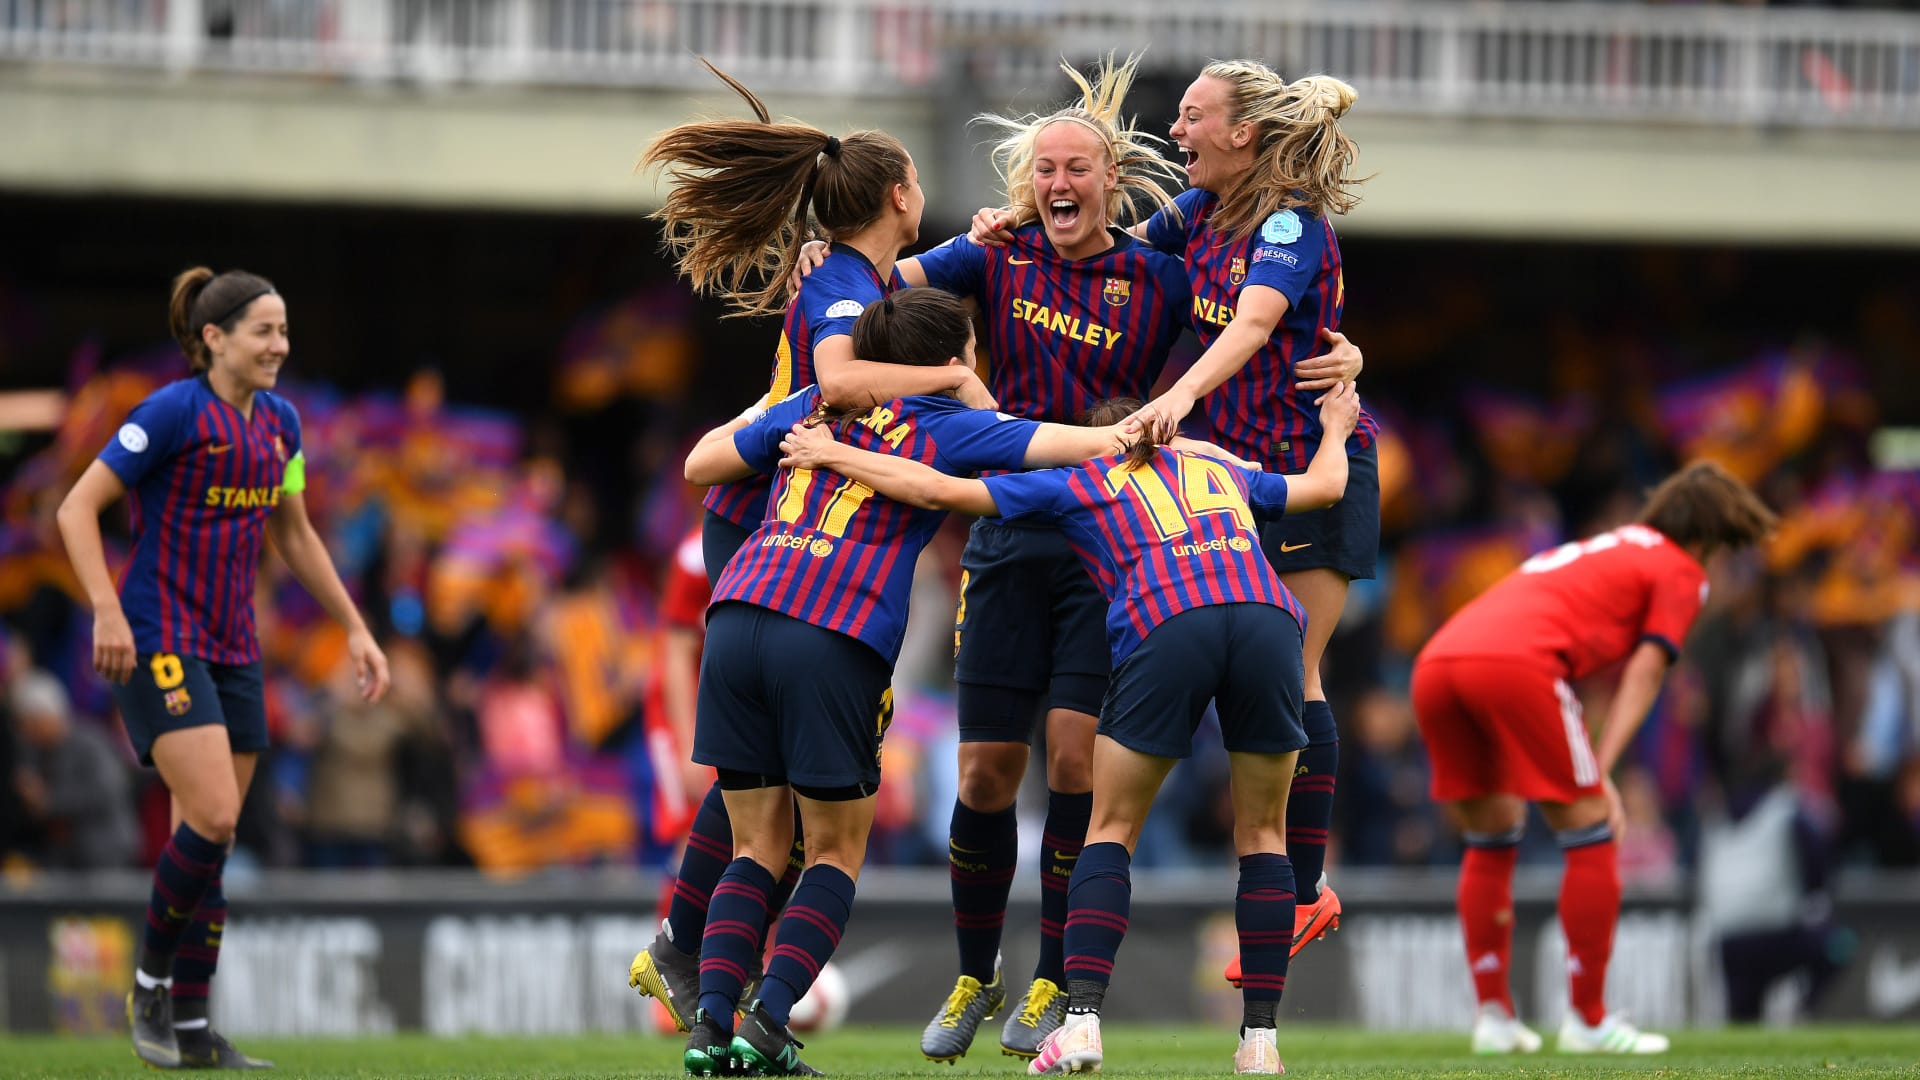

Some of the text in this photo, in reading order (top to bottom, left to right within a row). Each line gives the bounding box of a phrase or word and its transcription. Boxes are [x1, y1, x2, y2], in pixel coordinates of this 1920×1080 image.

[1262, 249, 1298, 266] RESPECT
[1012, 297, 1122, 350] STANLEY
[205, 485, 282, 508] STANLE
[1103, 452, 1258, 542] 14
[762, 530, 813, 551] unicef
[1172, 536, 1227, 557] unicef
[150, 652, 184, 689] 6
